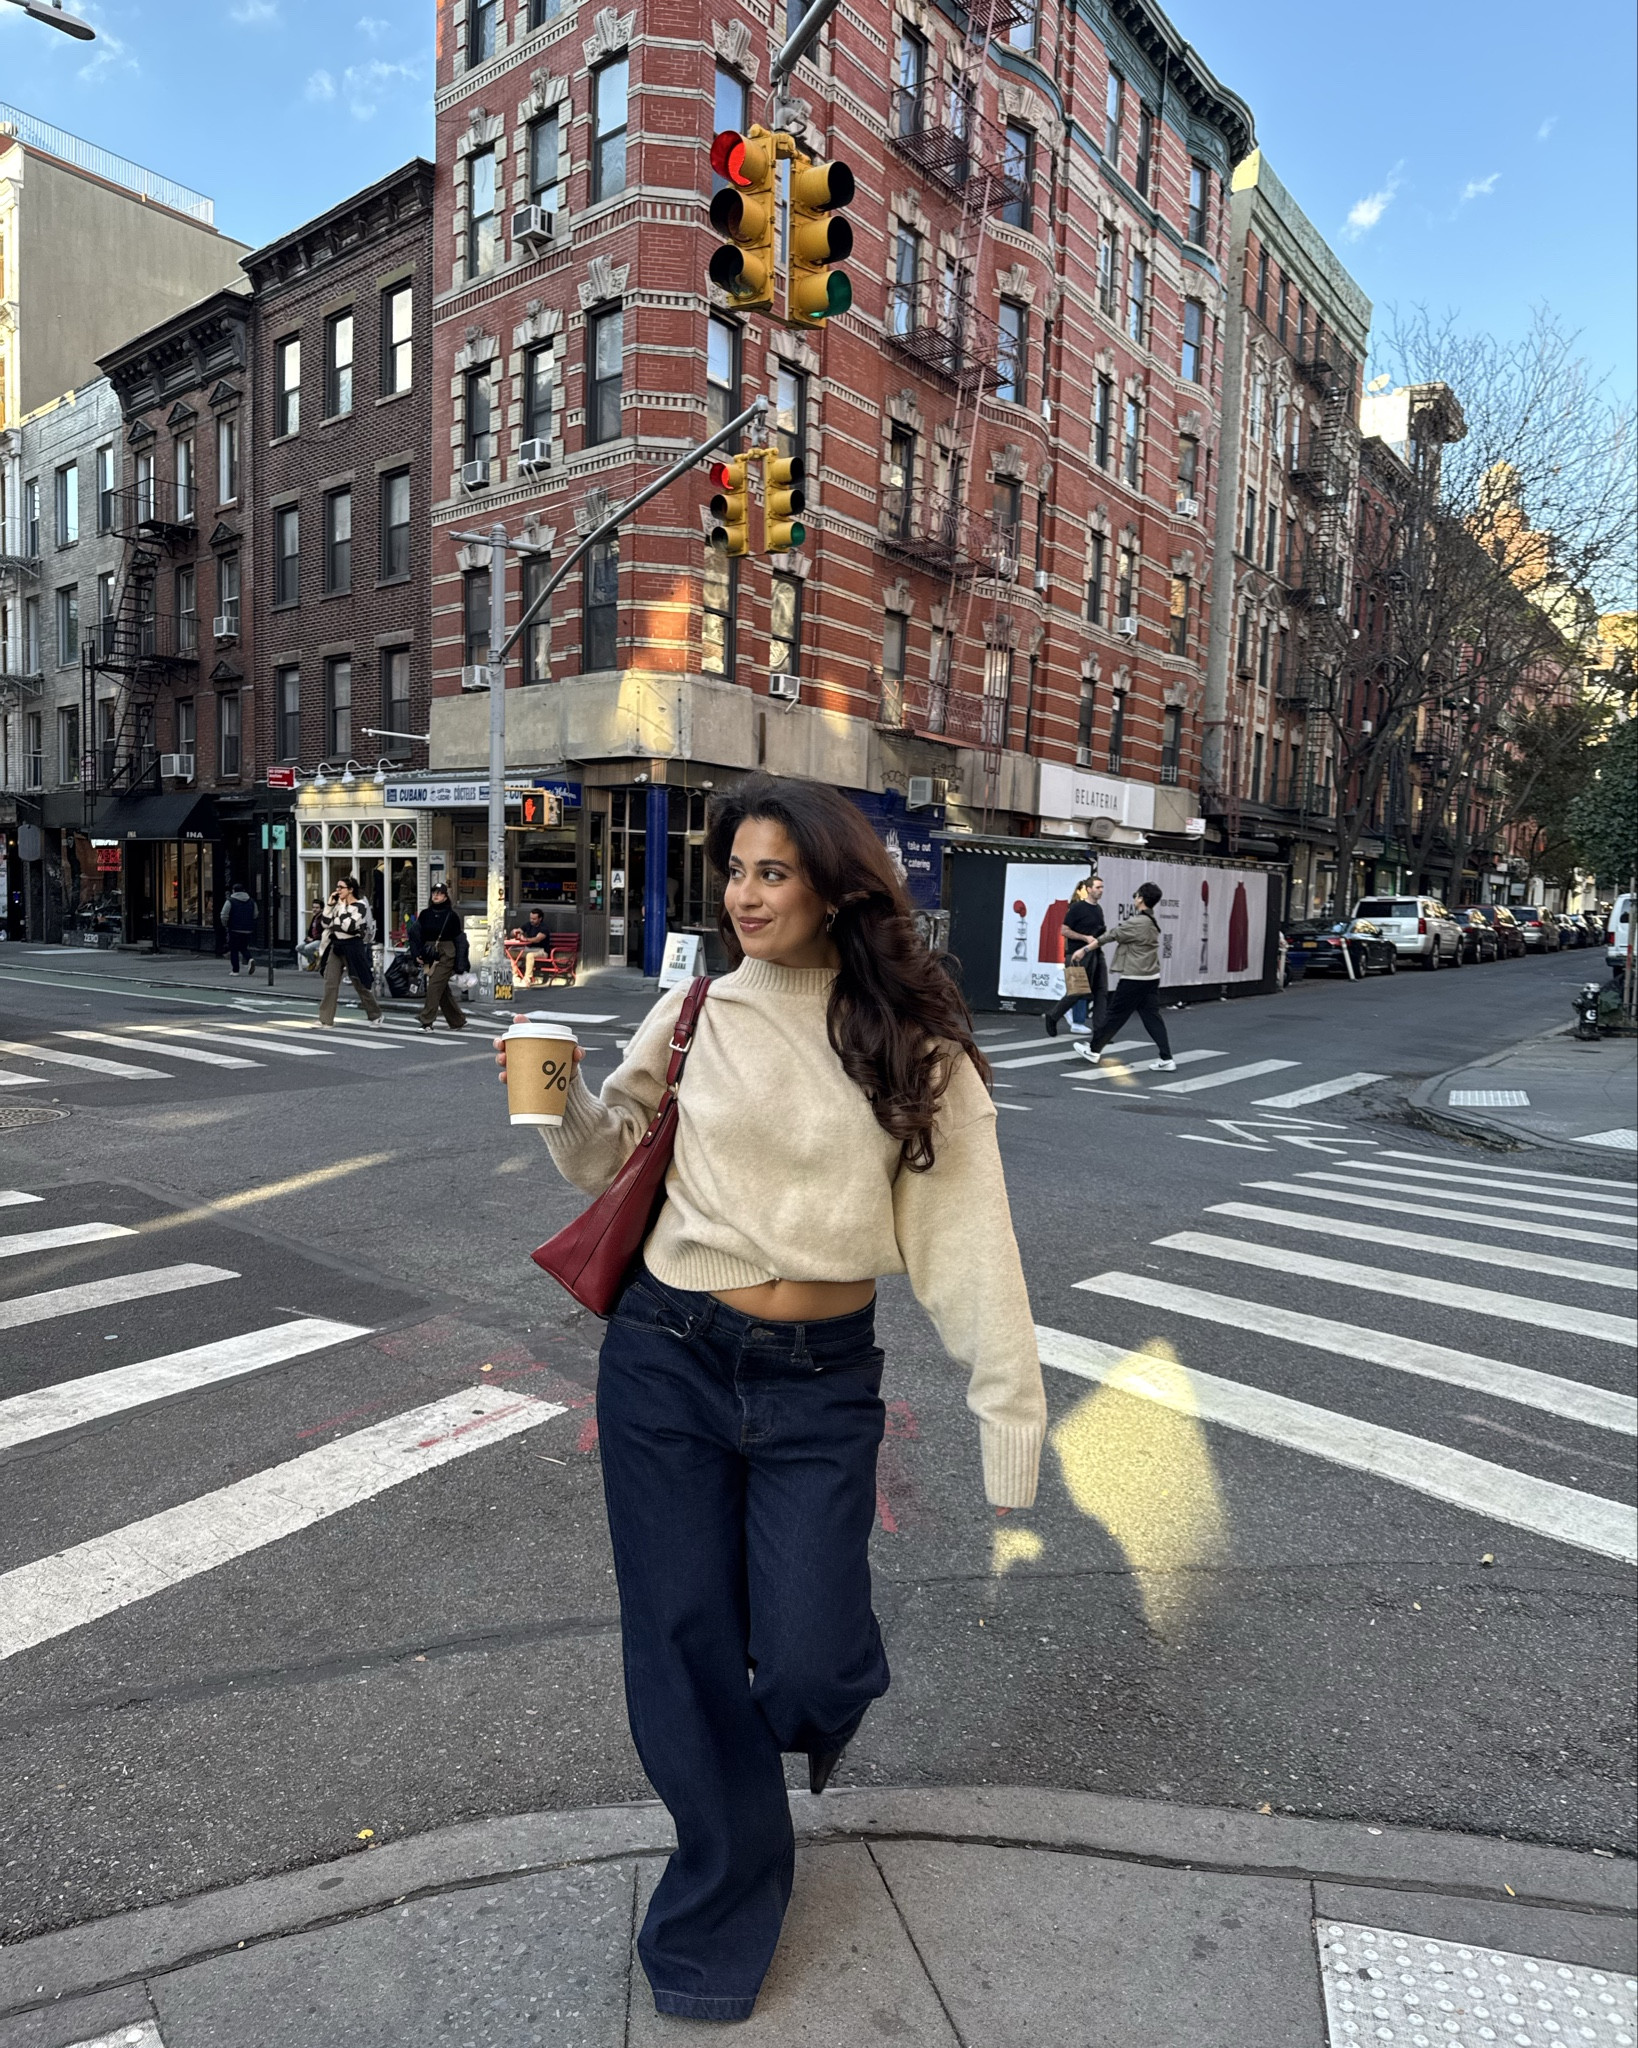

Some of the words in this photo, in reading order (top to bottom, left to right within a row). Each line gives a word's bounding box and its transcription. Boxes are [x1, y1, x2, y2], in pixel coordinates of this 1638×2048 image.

[400, 788, 428, 802] CUBANO
[1076, 788, 1118, 810] GELATERIA
[907, 841, 920, 852] take
[922, 843, 931, 852] out
[908, 859, 931, 871] catering
[613, 873, 622, 883] A
[84, 933, 98, 943] ZERO
